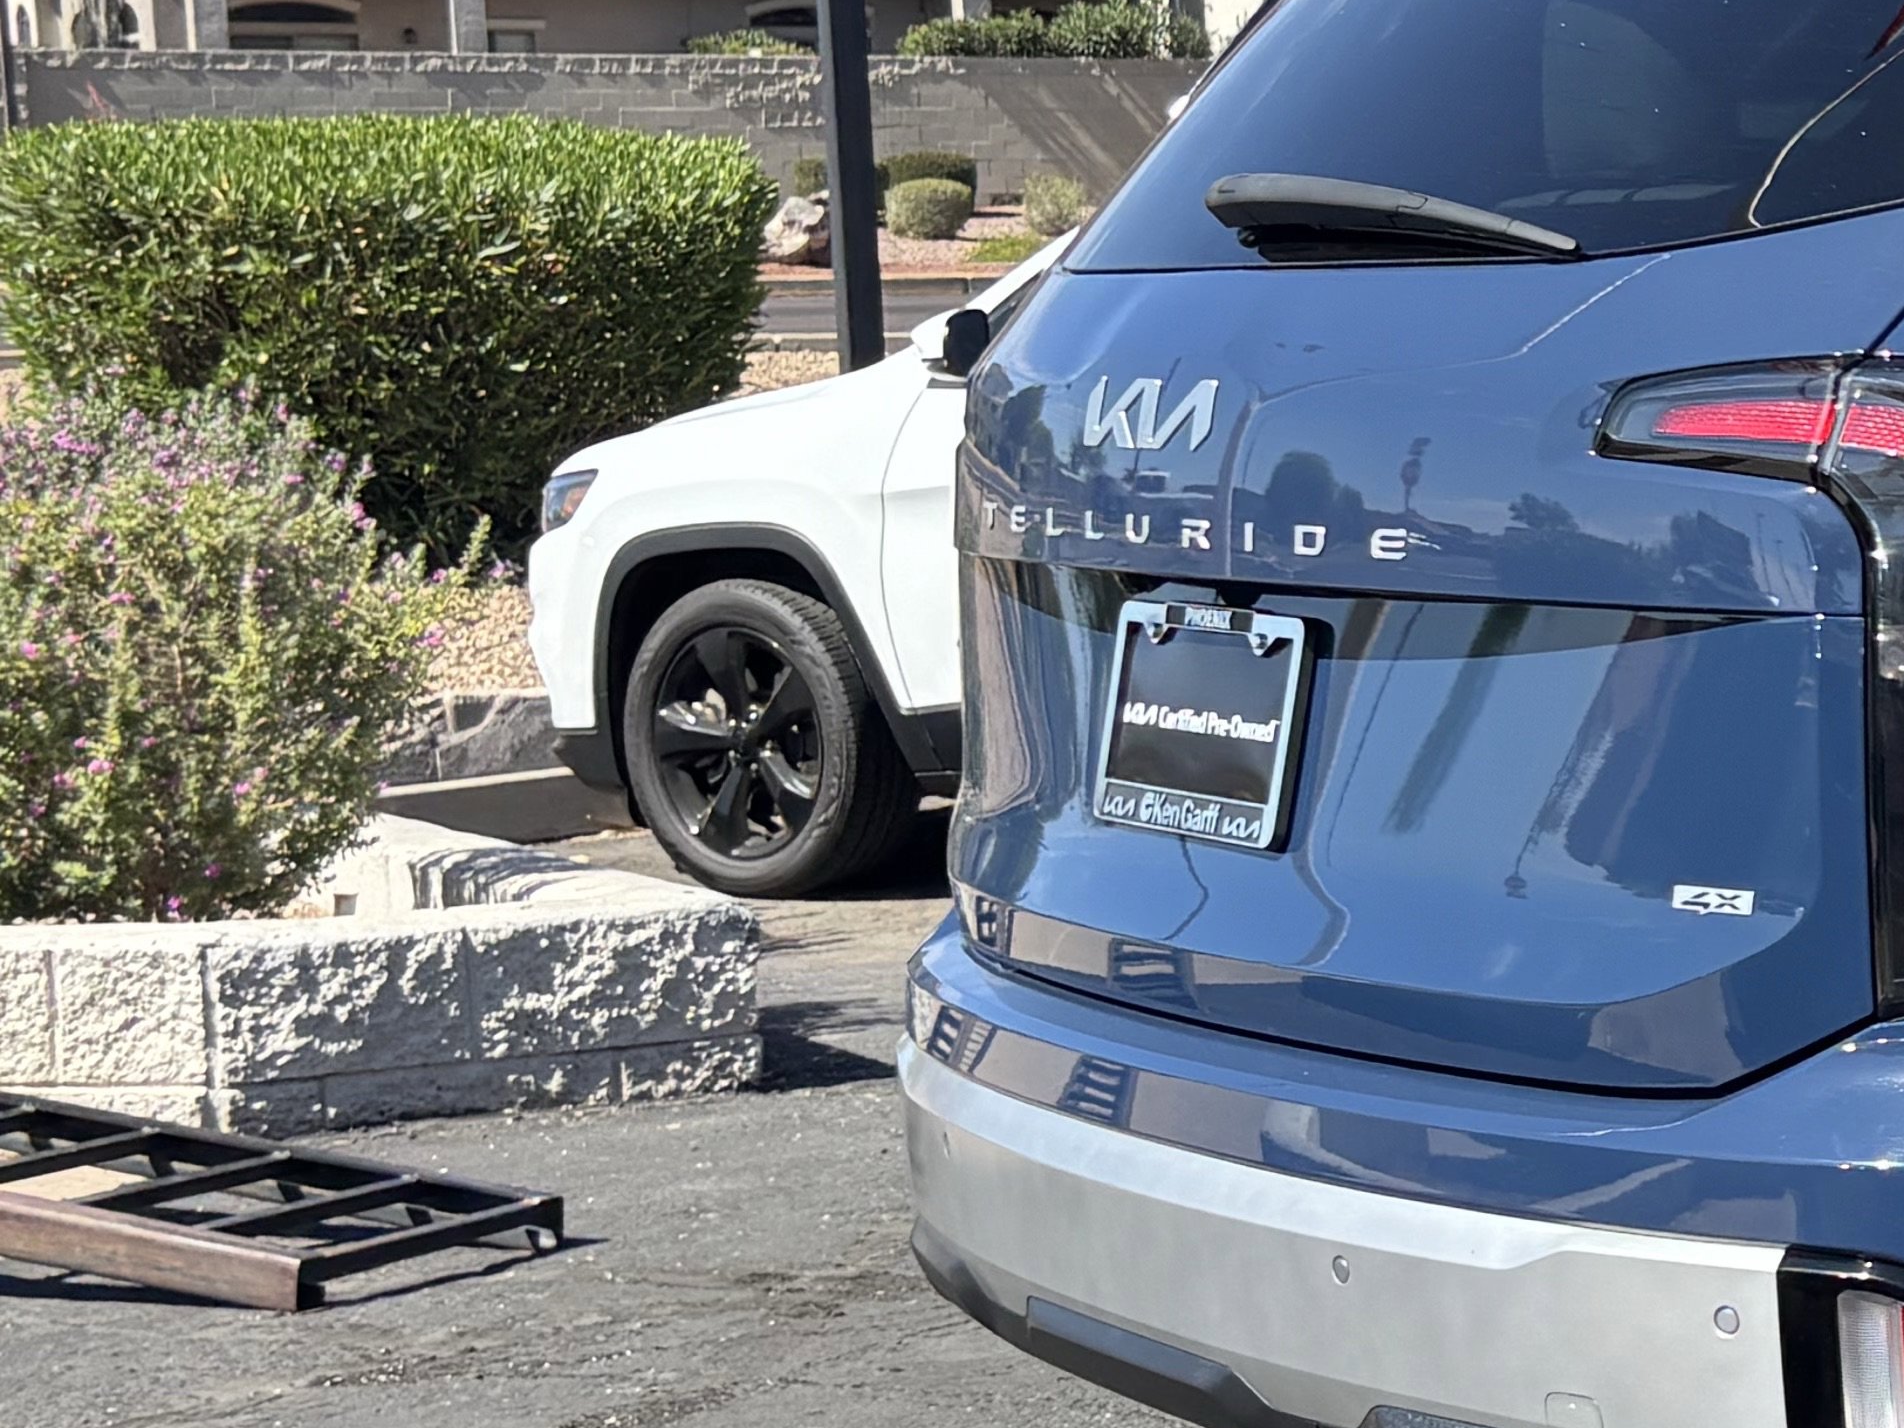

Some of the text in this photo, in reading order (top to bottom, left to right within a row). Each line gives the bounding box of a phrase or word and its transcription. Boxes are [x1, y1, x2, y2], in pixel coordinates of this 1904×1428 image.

[1083, 376, 1219, 450] KIA
[982, 501, 1408, 561] TELLURIDE
[1185, 606, 1232, 630] PHOENIX
[1123, 701, 1158, 725] KIA
[1158, 706, 1208, 734] Certified
[1151, 793, 1181, 828] Ken
[1181, 799, 1222, 834] Garff
